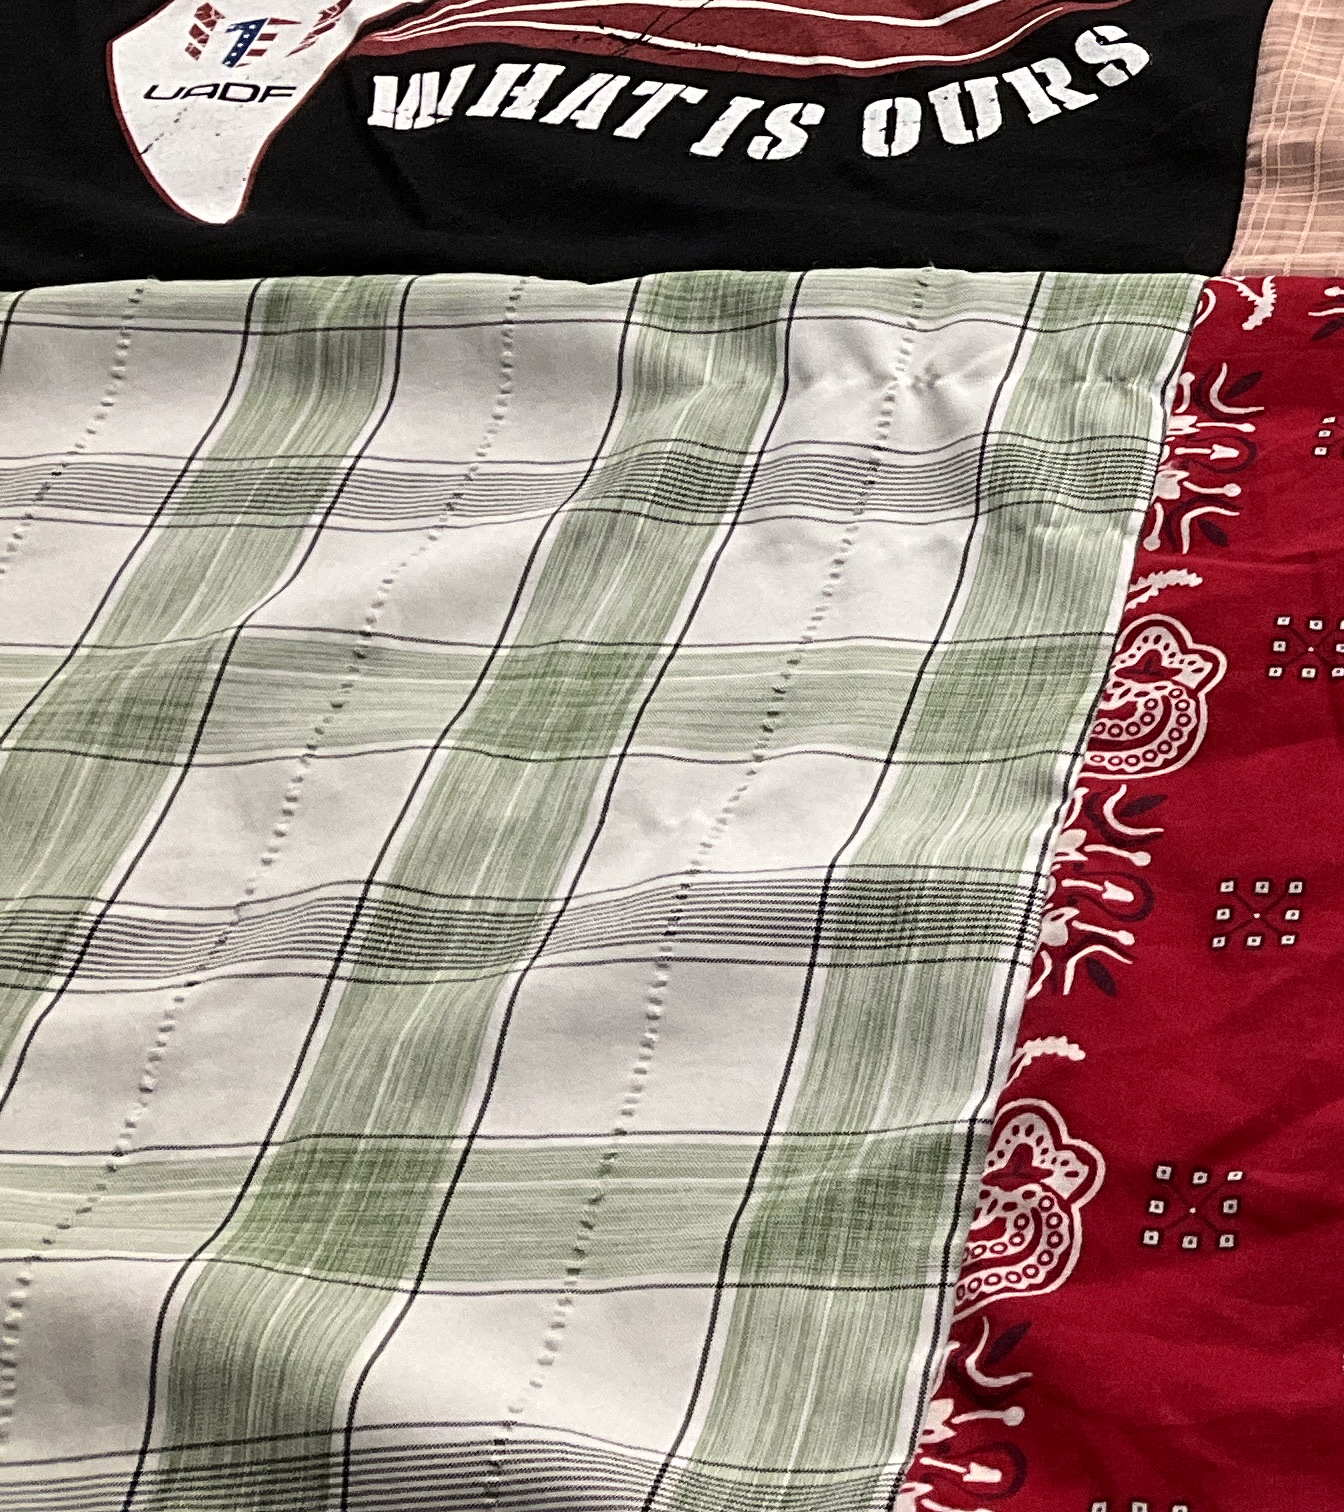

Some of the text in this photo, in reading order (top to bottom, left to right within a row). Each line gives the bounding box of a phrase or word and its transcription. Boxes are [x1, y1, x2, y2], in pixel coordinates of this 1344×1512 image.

[143, 82, 297, 104] UADF
[367, 23, 1153, 161] WHAT IS OURS
